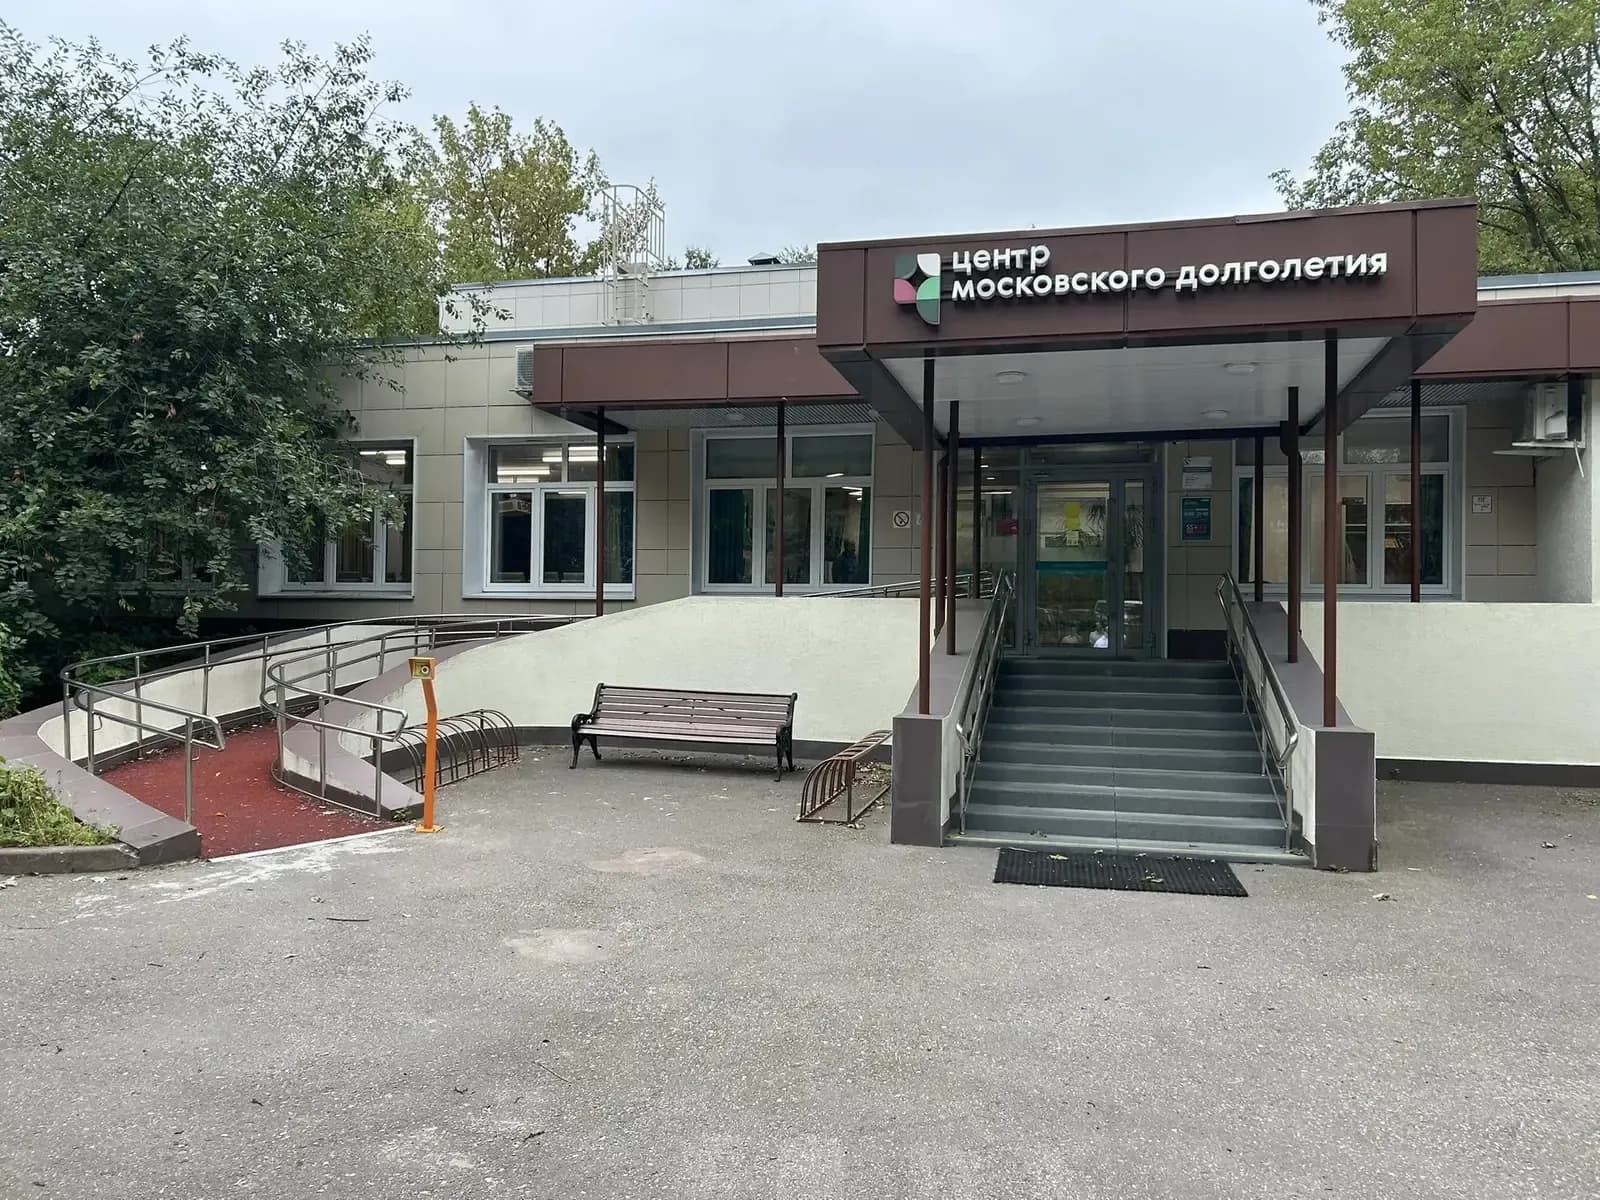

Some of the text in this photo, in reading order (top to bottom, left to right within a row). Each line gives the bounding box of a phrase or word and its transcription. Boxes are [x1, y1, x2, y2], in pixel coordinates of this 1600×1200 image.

[951, 252, 1388, 302] московского долголетия
[952, 244, 1051, 275] центр
